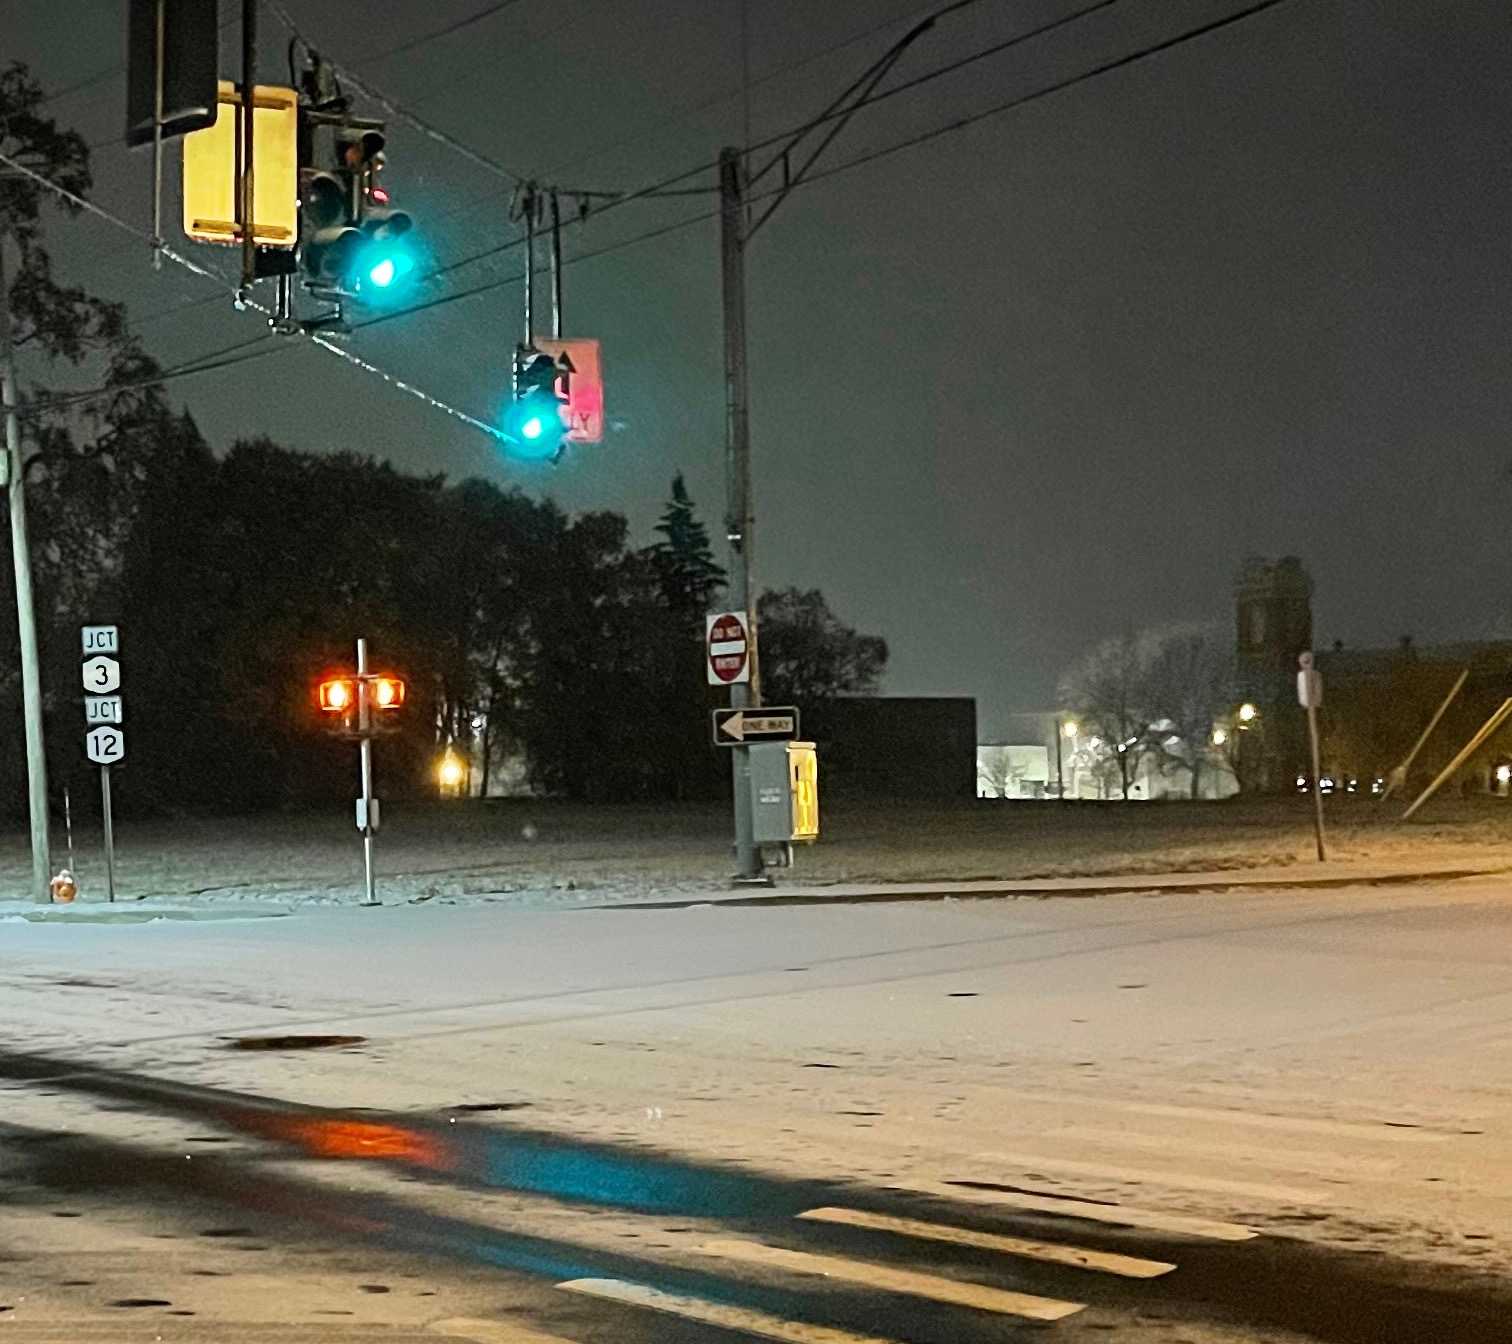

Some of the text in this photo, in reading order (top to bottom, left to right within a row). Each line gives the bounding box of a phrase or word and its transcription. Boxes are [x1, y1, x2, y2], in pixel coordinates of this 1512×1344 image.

[86, 632, 114, 648] JCT
[95, 665, 108, 685] 3
[90, 702, 116, 718] JCT
[94, 735, 117, 756] 12
